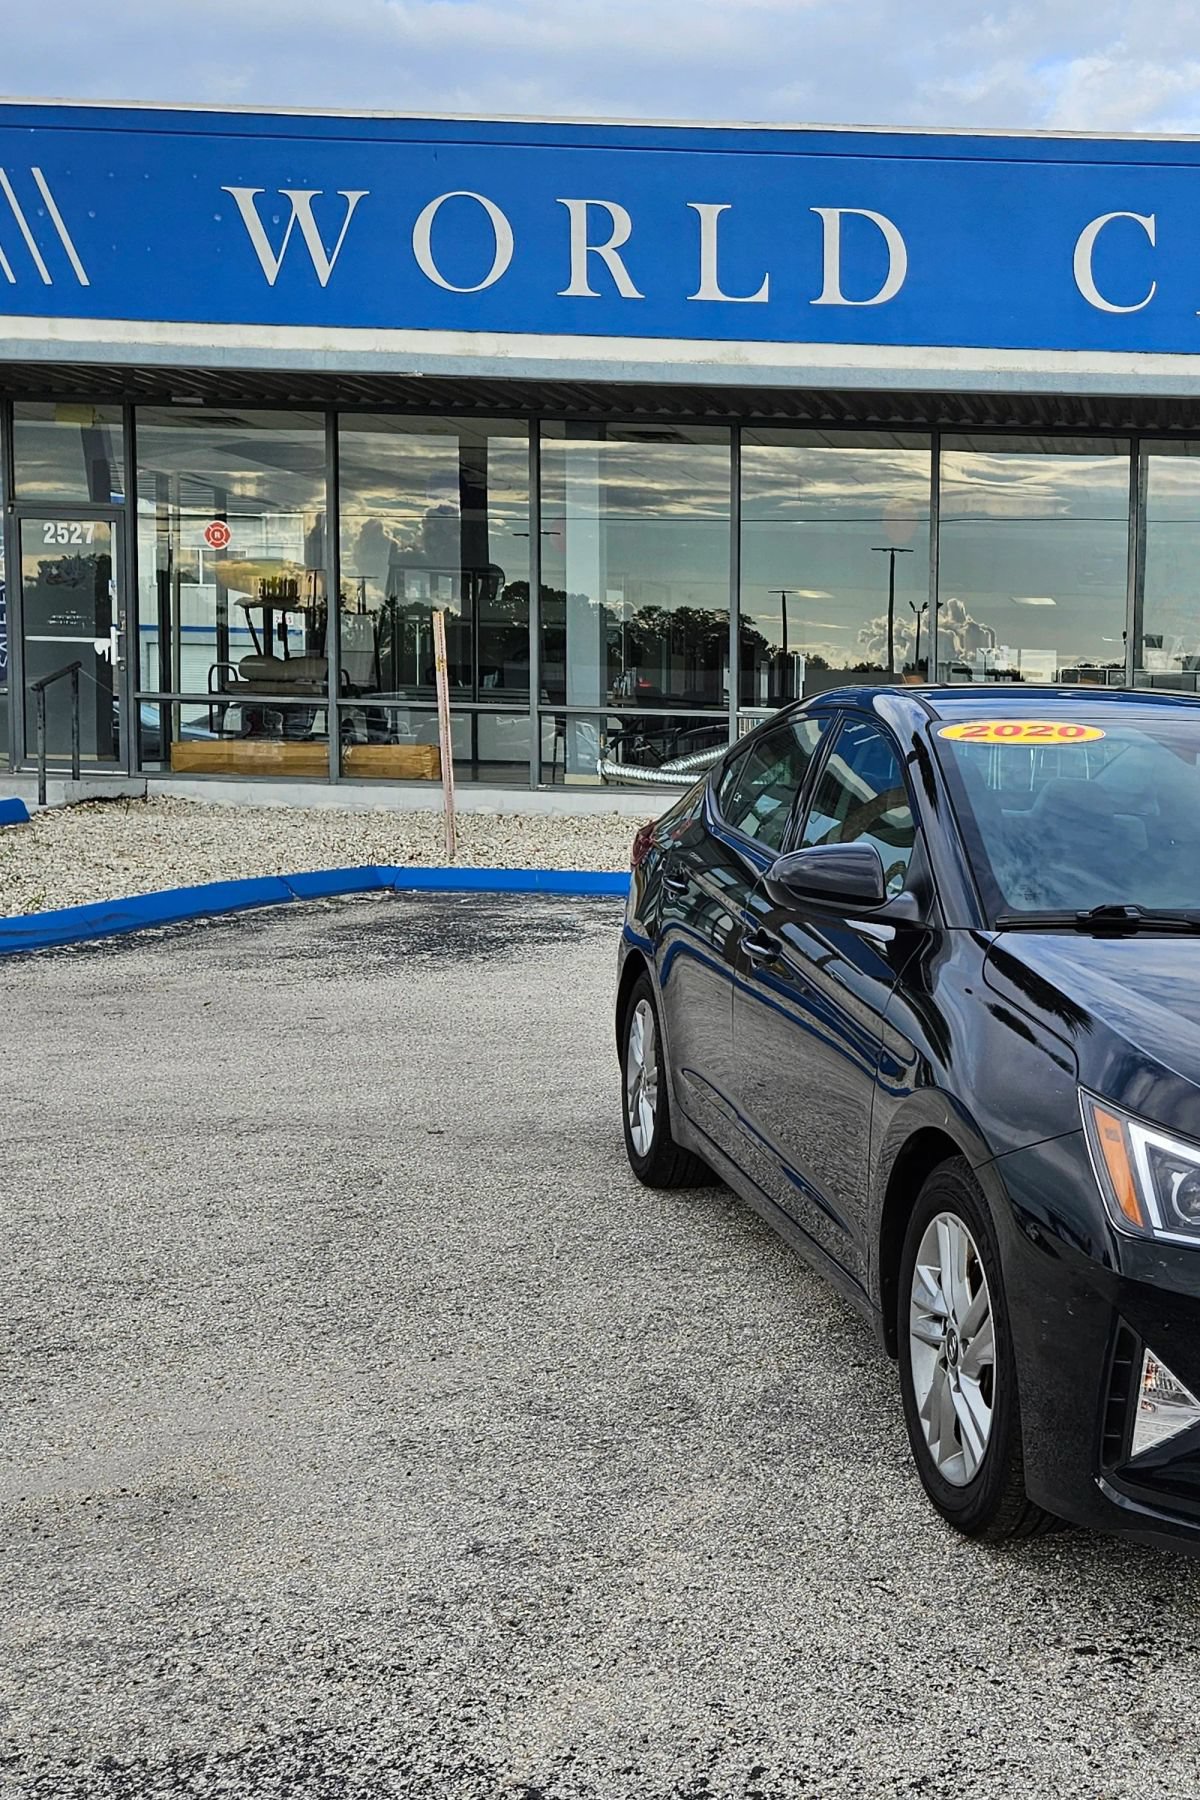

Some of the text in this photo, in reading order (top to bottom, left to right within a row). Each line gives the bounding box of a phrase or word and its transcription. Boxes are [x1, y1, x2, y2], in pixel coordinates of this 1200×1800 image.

[222, 186, 908, 306] WORLD
[43, 522, 94, 544] 2527
[959, 724, 1086, 738] 2020
